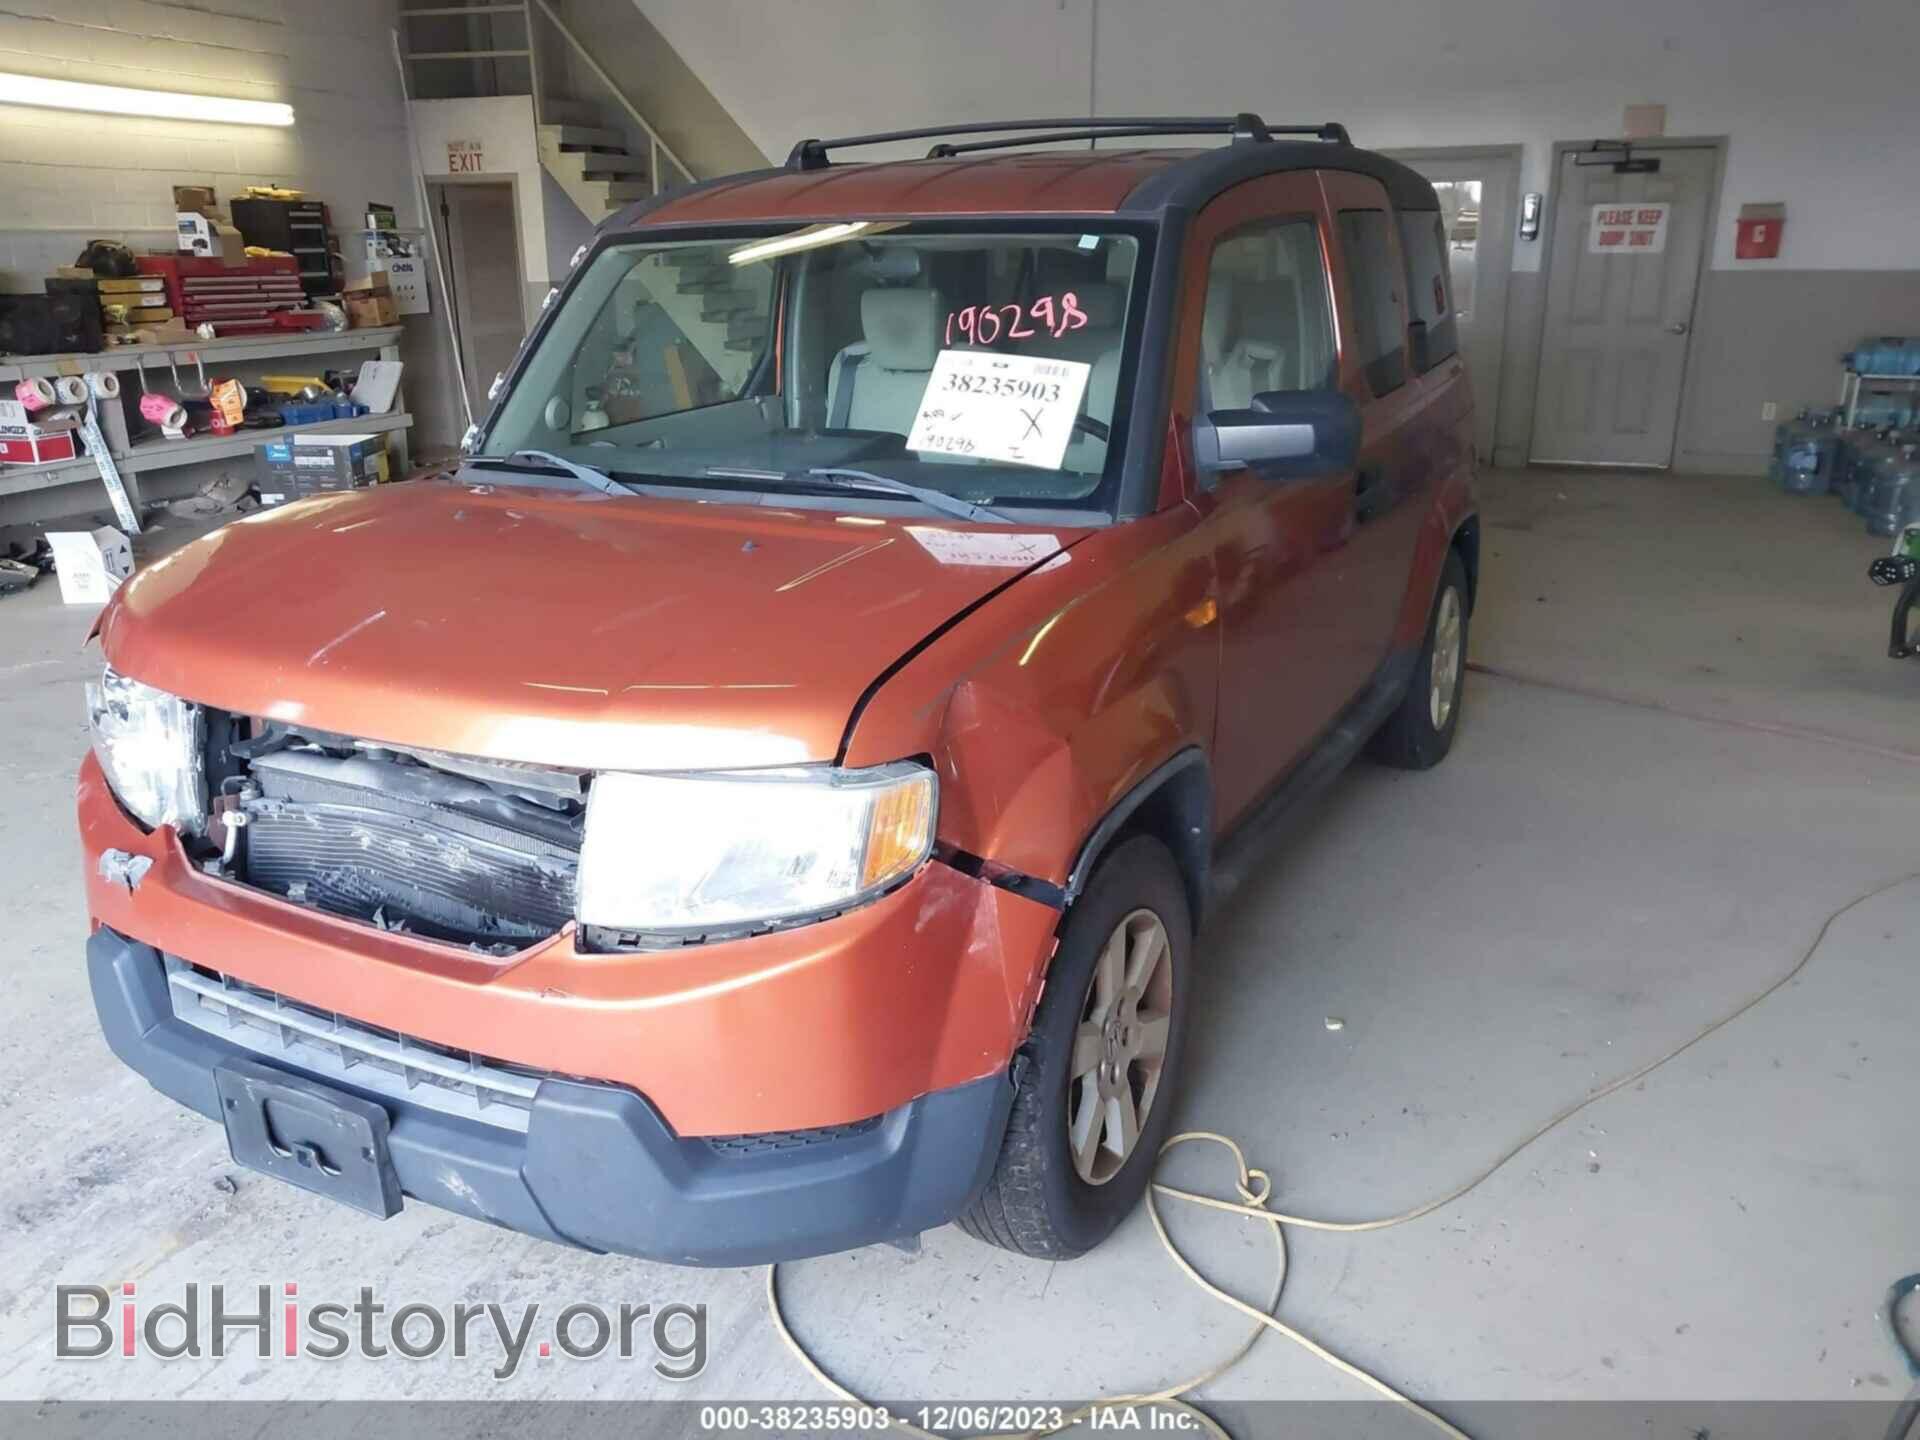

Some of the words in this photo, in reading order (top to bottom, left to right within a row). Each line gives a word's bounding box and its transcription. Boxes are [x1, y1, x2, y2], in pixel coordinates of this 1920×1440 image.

[449, 152, 483, 172] EXIT
[1598, 209, 1633, 226] PLEASE
[945, 291, 1089, 346] 190298
[942, 373, 1061, 402] 38235903
